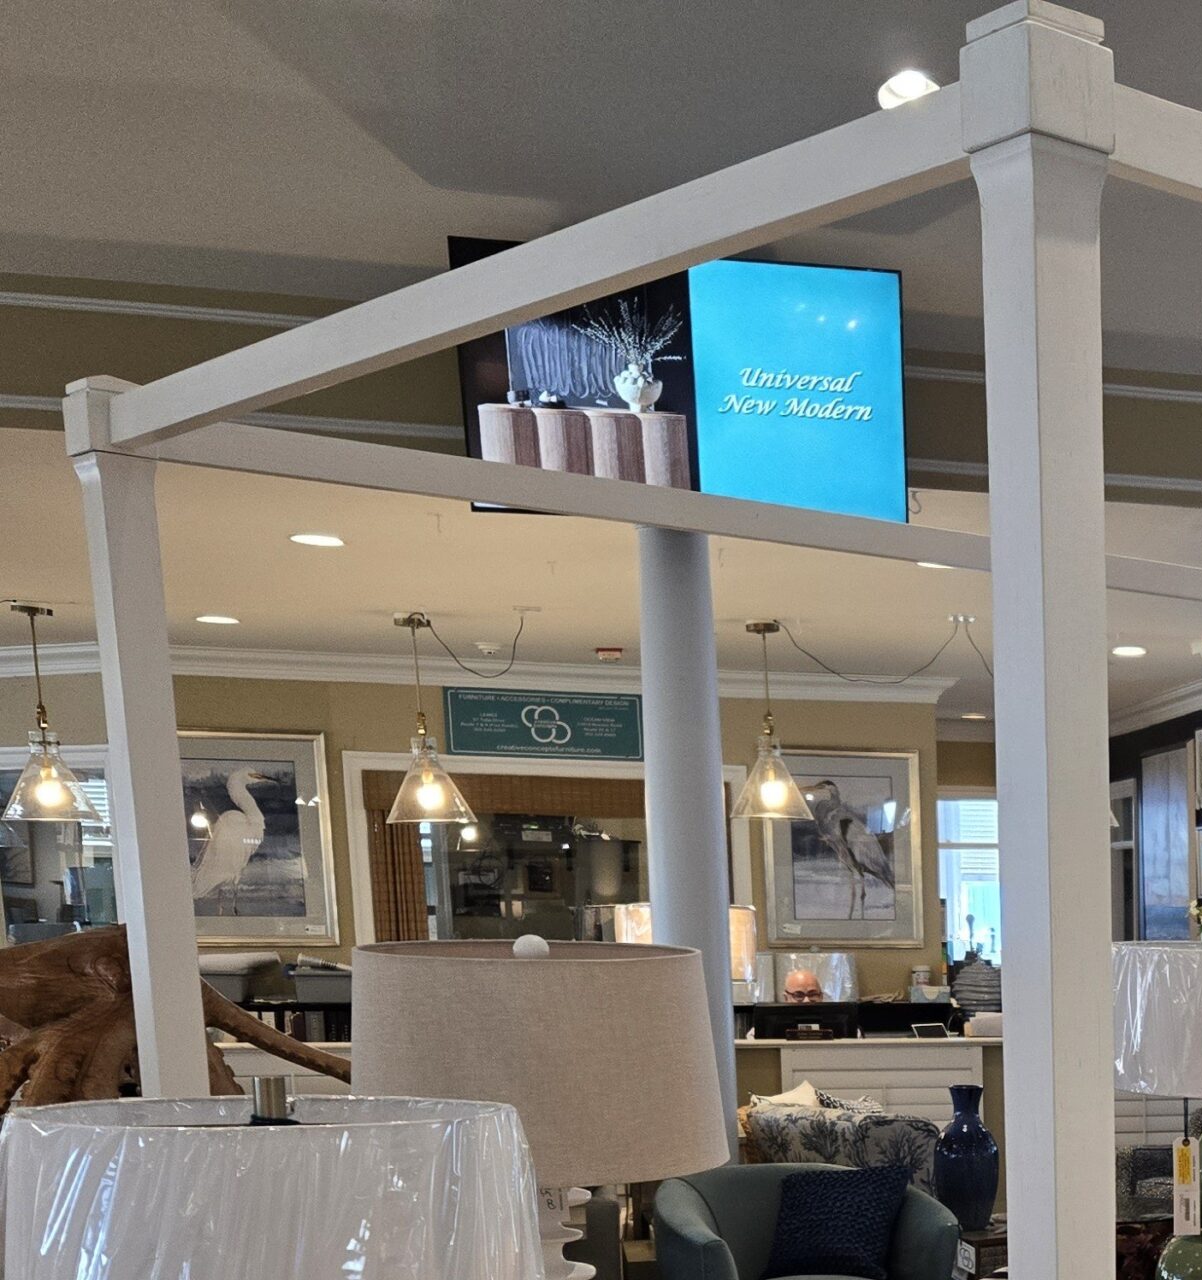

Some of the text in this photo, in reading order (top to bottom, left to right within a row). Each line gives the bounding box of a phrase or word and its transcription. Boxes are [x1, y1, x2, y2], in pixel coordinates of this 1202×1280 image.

[739, 367, 862, 393] Universal
[718, 393, 874, 421] New Modern
[458, 693, 630, 707] FURNITURE ACCESSORIES COMPLIMENTARY DESIGN
